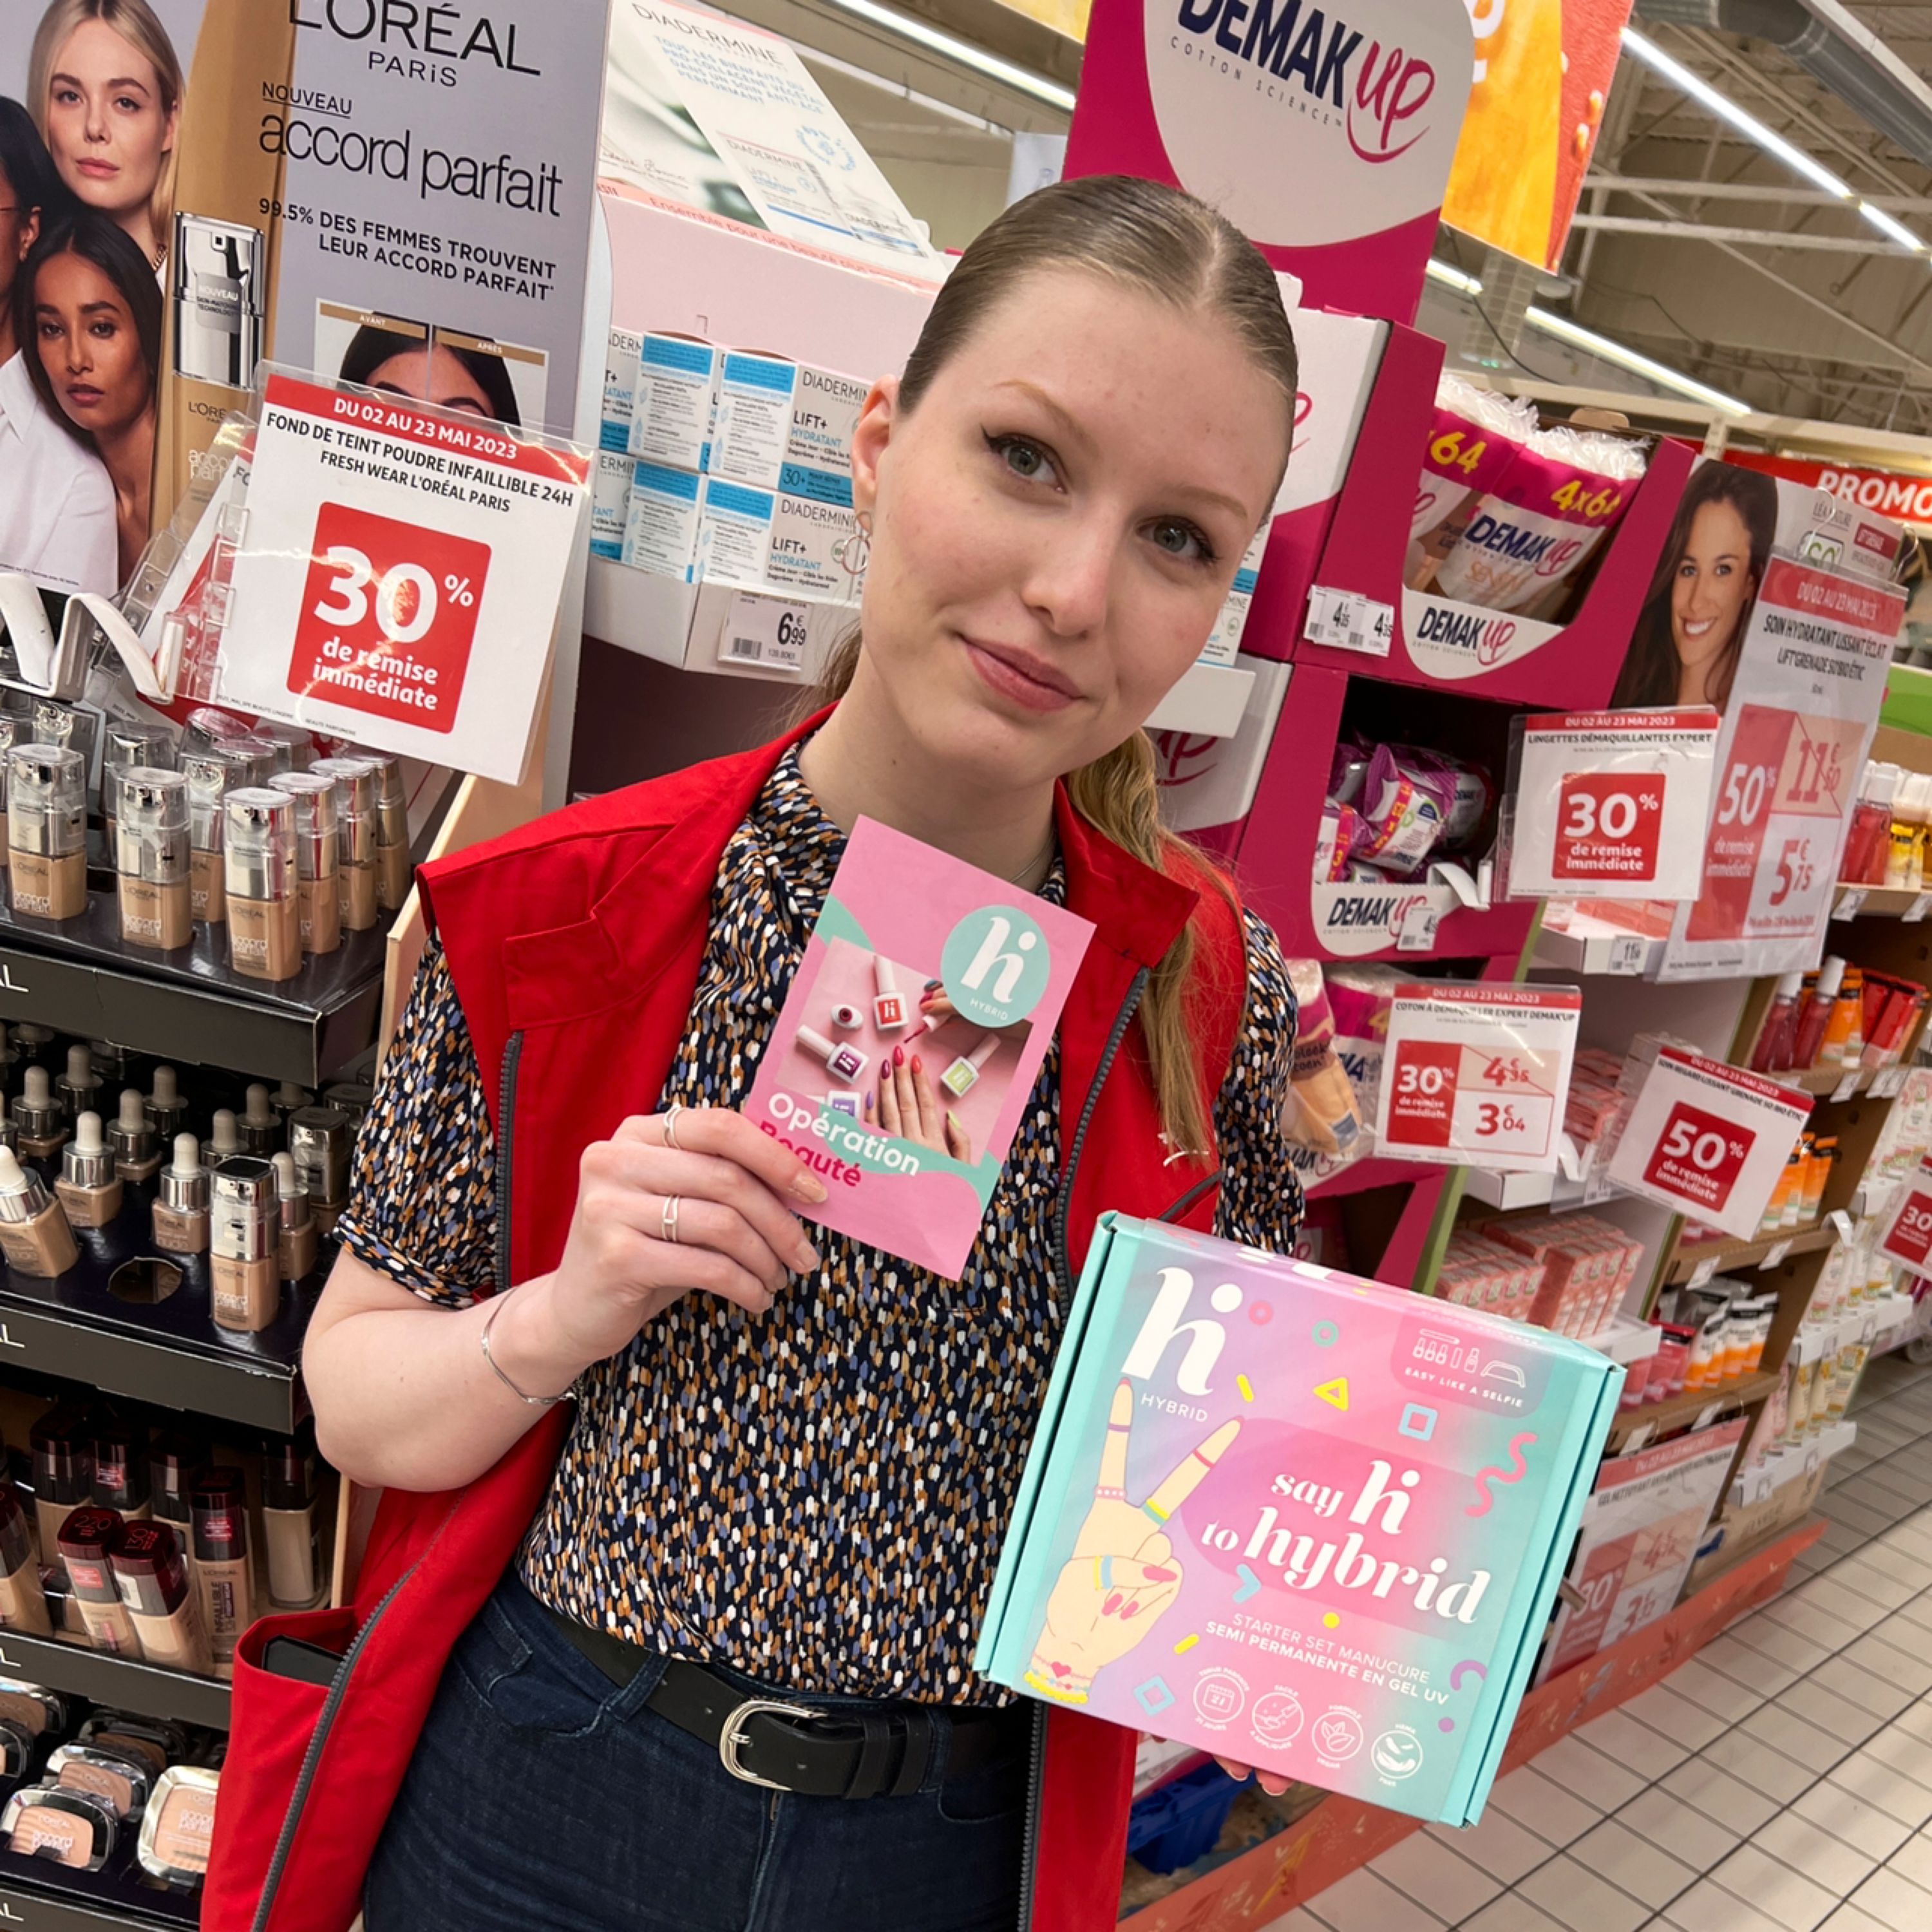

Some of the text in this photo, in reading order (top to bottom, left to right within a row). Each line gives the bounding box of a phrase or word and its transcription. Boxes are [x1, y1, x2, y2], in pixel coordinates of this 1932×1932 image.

[288, 0, 541, 76] LORÉAL
[632, 3, 782, 66] DIADERMINE
[1170, 35, 1242, 80] COTTON
[262, 82, 352, 115] NOUVEAU
[259, 114, 410, 182] accord
[421, 148, 564, 218] parfait
[259, 198, 557, 280] 99.5% DES FEMMES TROUVENT
[319, 234, 368, 260] LEUR
[374, 247, 458, 279] ACCORD
[359, 314, 386, 327] AVANT
[802, 371, 867, 403] DIADERMIN
[334, 398, 518, 460] DU 02 AU 23 MAI 2023
[793, 410, 828, 430] LIFT+
[791, 427, 842, 448] HYDRATANT
[266, 412, 574, 507] FOND DE TEINT POUDRE INFAILLIBLE 24H
[319, 451, 512, 513] FRESH WEAR L'ORÉAL PARIS
[782, 466, 806, 487] 30+
[772, 536, 807, 554] LIFT+
[770, 553, 822, 571] HYDRATANT
[323, 637, 439, 686] de remise
[312, 658, 439, 711] immédiate
[1528, 734, 1579, 744] LINGETTES
[1581, 732, 1670, 744] DÉMAQUILLANTES
[1565, 717, 1675, 727] DU 02 AU 23 MAI 2023
[1570, 844, 1643, 857] de remise
[1713, 837, 1756, 857] de remise
[1566, 857, 1644, 872] immédiate
[1705, 858, 1752, 878] immédiate
[960, 917, 1037, 1004] hi
[969, 996, 1009, 1021] HYBRID
[1396, 1001, 1425, 1011] COTON
[1433, 987, 1540, 1004] DU 02 AU 23 MAI 2023
[1394, 1106, 1447, 1119] immédiate
[1399, 1095, 1445, 1108] de remise
[768, 1091, 920, 1177] Opération
[1655, 1166, 1717, 1202] immédiate
[1662, 1159, 1719, 1190] de remise
[1120, 1266, 1244, 1397] hi
[1405, 1367, 1524, 1408] EASY LIKE A SELFIE
[1141, 1392, 1209, 1423] HYBRID
[1271, 1459, 1421, 1535] say hi
[74, 1515, 111, 1531] 220
[1201, 1506, 1492, 1625] to hybrid
[1206, 1620, 1450, 1706] SEMI PERMANENTE EN GEL UV
[1232, 1613, 1431, 1685] STARTER SET MANUCURE
[1209, 1693, 1226, 1707] 21
